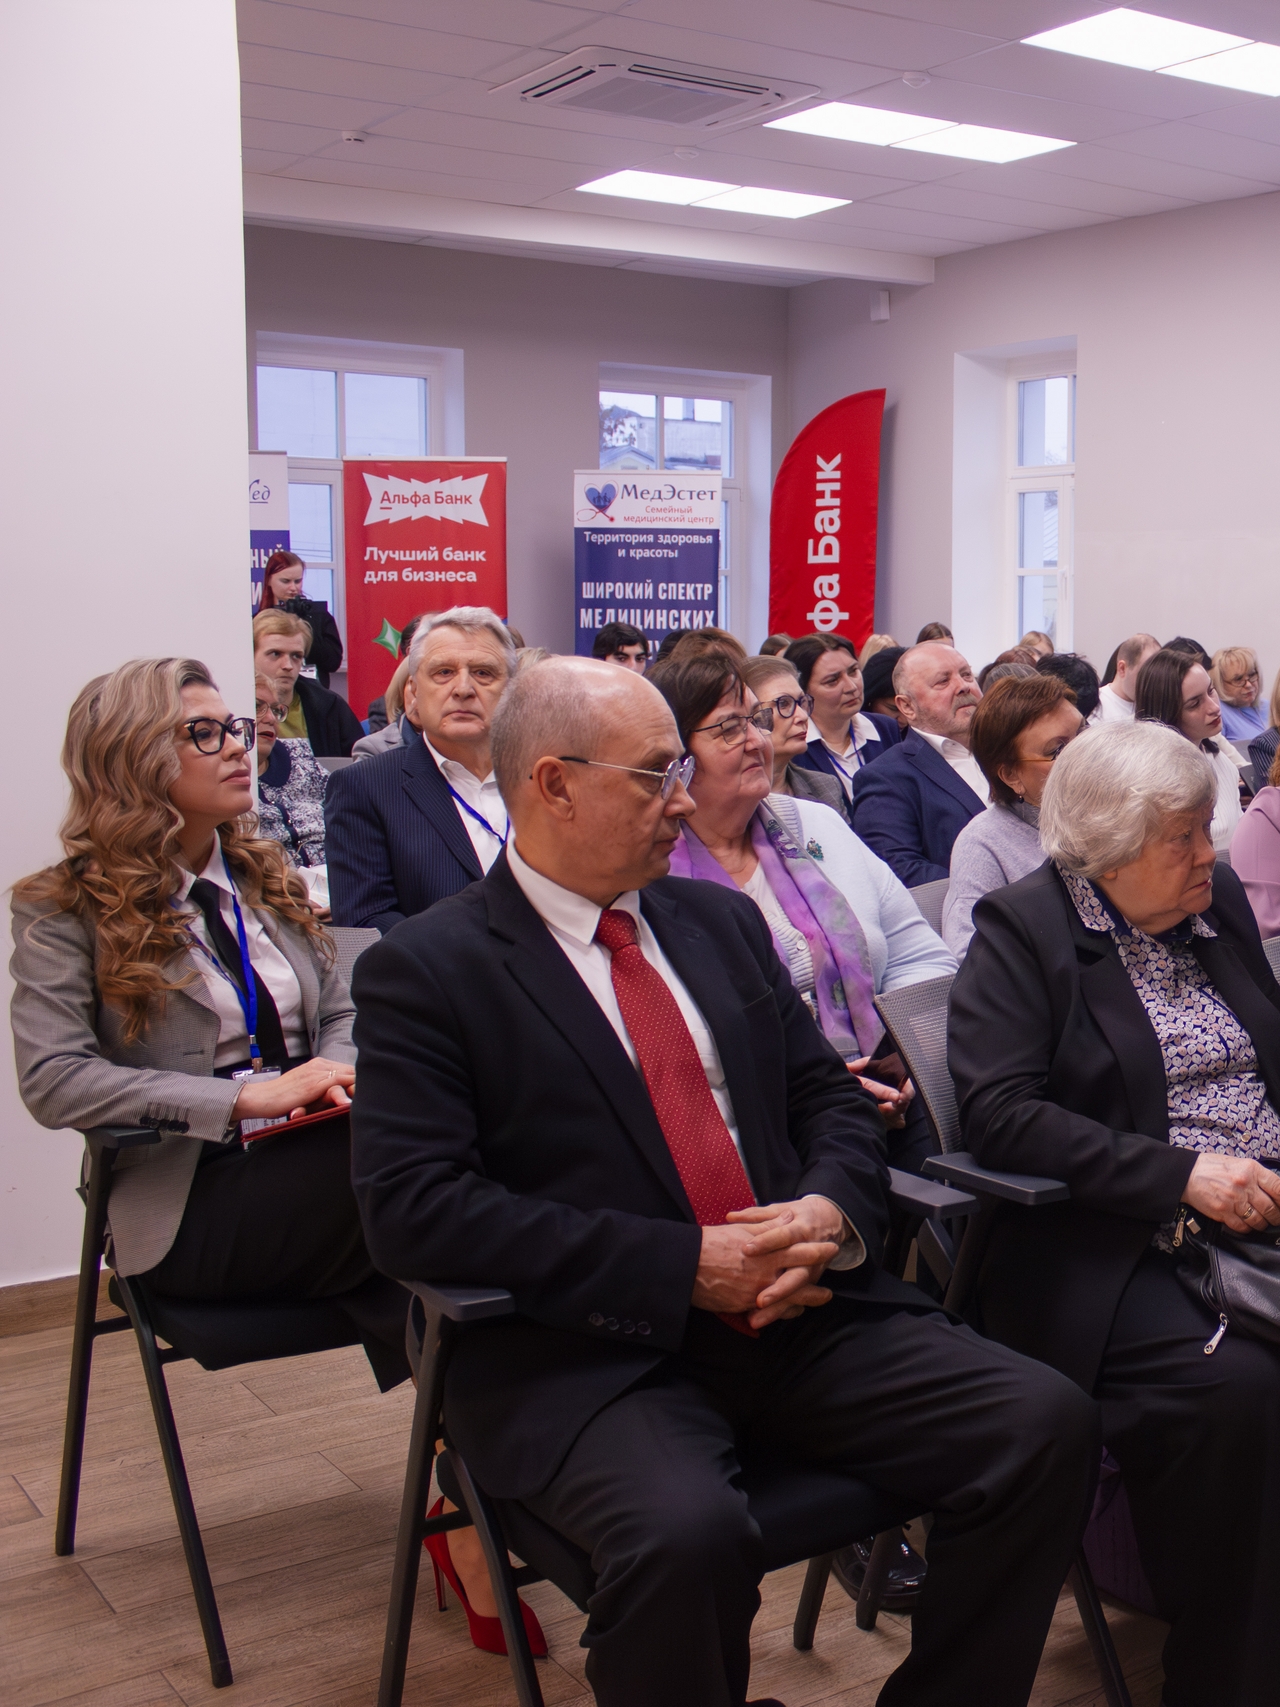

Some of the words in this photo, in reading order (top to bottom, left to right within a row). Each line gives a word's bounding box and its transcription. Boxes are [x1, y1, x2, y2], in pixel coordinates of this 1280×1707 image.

[380, 490, 431, 508] Альфа
[434, 491, 473, 505] Банк
[620, 483, 718, 503] МедЭстет
[645, 505, 693, 514] Семейный
[806, 453, 842, 564] Банк
[623, 514, 686, 524] медицинский
[687, 516, 715, 525] центр
[583, 531, 654, 546] Территория
[657, 533, 713, 546] здоровья
[364, 546, 439, 564] Лучший
[442, 547, 487, 562] банк
[617, 549, 626, 558] и
[629, 549, 679, 560] красоты
[363, 570, 399, 584] для
[402, 567, 477, 583] бизнеса
[582, 579, 654, 600] ШИРОКИЙ
[658, 582, 714, 601] СПЕКТР
